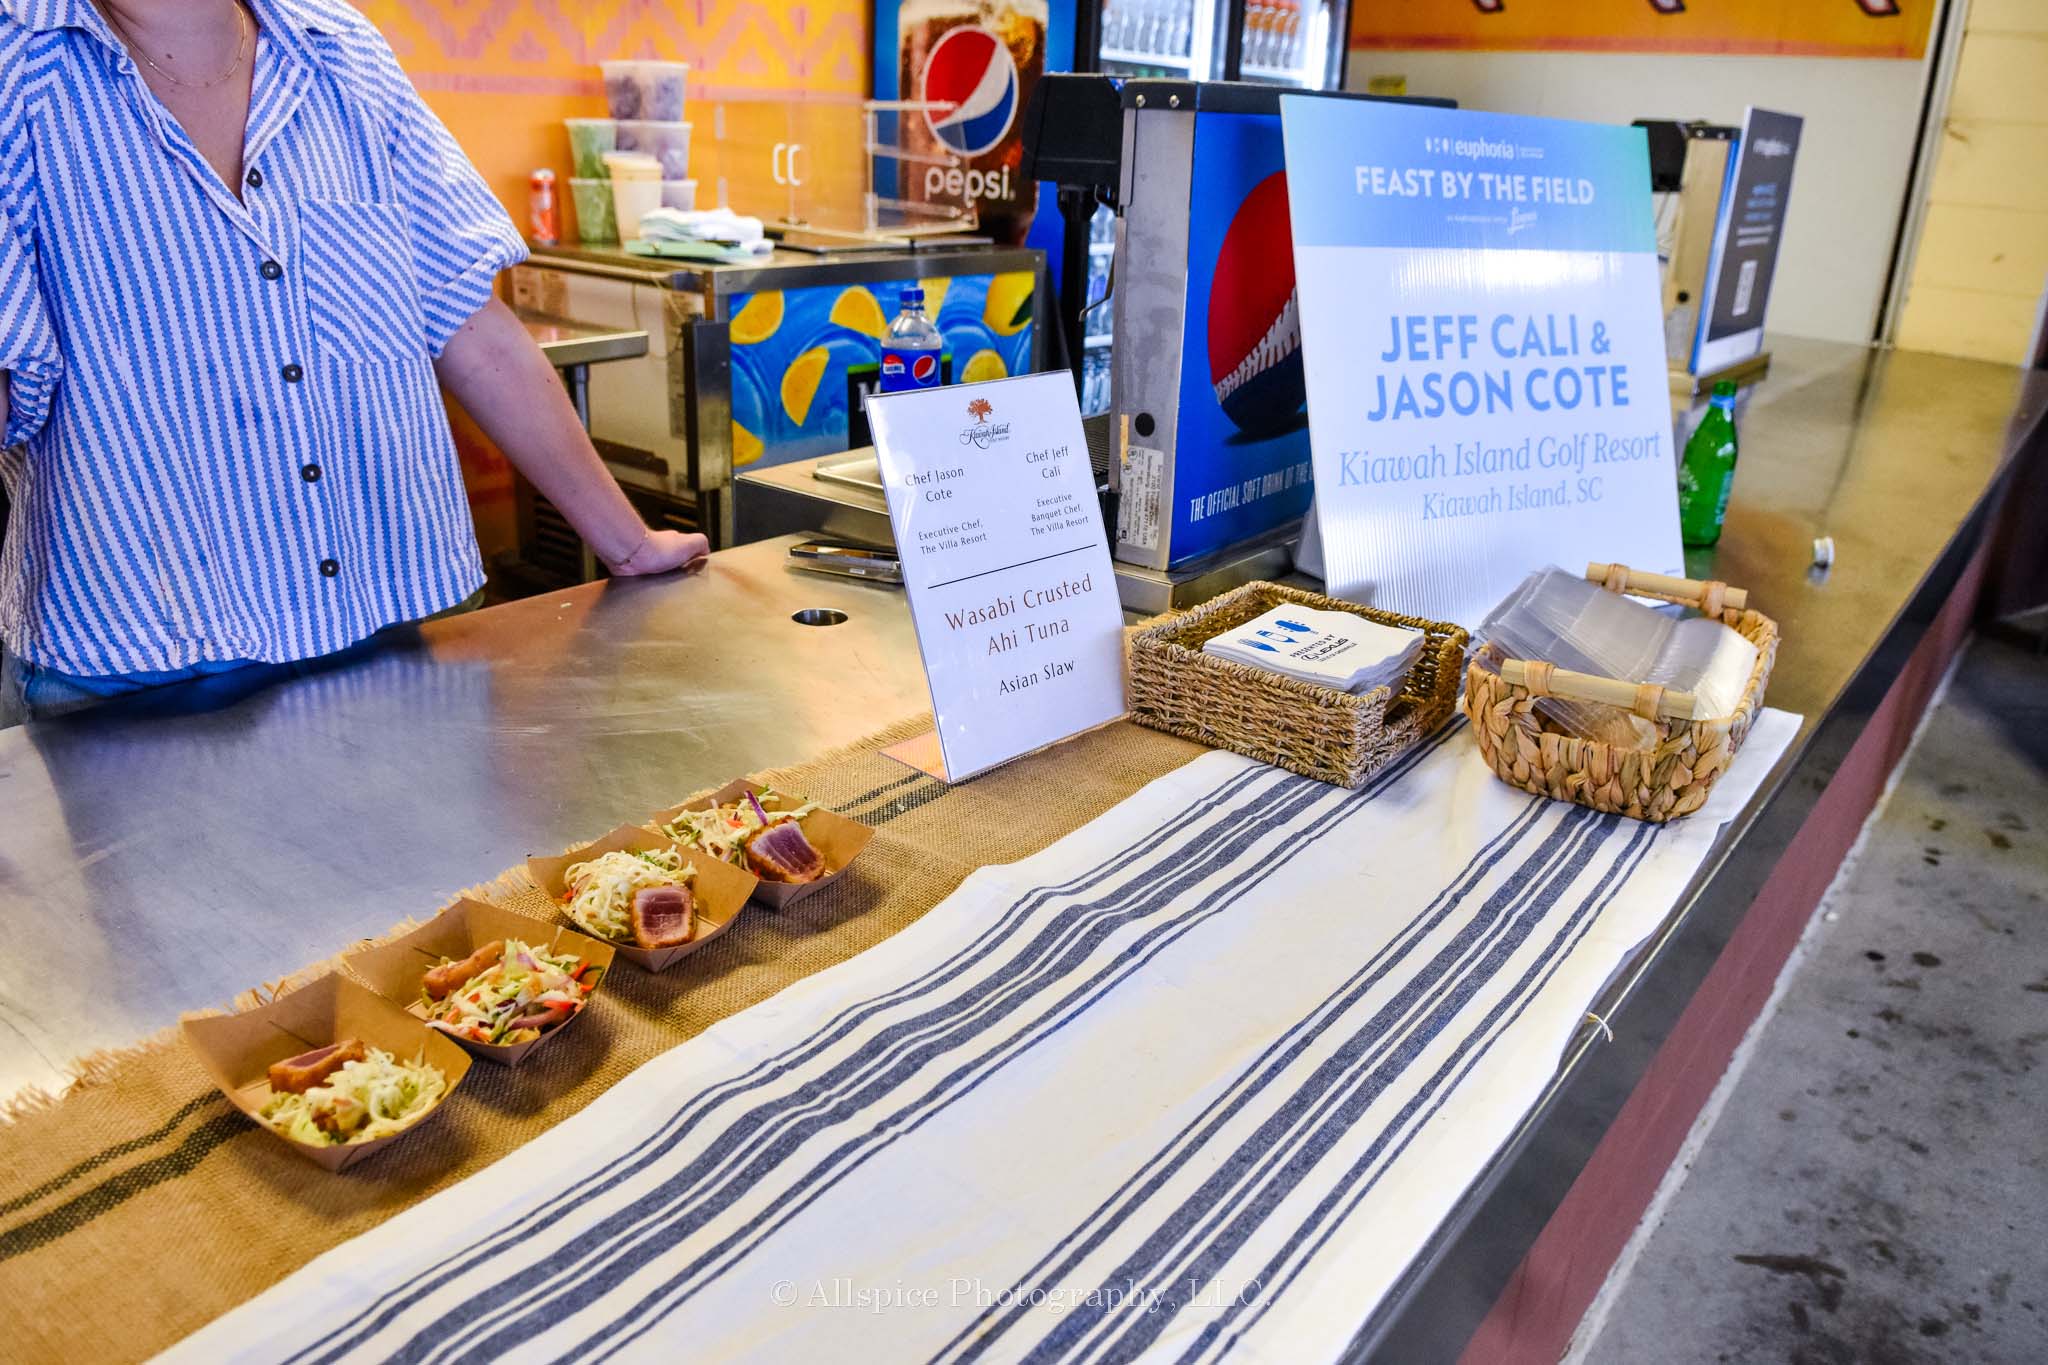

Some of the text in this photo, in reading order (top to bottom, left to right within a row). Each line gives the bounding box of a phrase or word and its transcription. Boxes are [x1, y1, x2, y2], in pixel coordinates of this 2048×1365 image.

[1455, 136, 1514, 160] euphoria
[925, 164, 1010, 206] pepsi
[1355, 166, 1595, 205] FEAST BY THE FIELD
[1381, 314, 1611, 362] JEFF CALI &
[1367, 365, 1630, 422] JASON COTE
[1026, 446, 1069, 464] Chef Jeff
[1338, 431, 1661, 487] Kiawah Island Golf Resort
[905, 467, 964, 487] Chef Jason
[1042, 465, 1061, 479] Cali
[926, 488, 952, 502] Cote
[1037, 494, 1072, 507] Executive
[1190, 496, 1205, 523] THE
[1207, 484, 1240, 517] OFFICIAL
[1242, 477, 1261, 504] SOFT
[1422, 476, 1604, 520] Kiawah Island, SC
[1031, 508, 1062, 522] Banquet
[1031, 515, 1089, 536] The Villa Resort
[918, 526, 959, 541] Executive
[920, 532, 987, 555] The Villa Resort
[945, 573, 1092, 631] Wasabi Crusted
[988, 619, 1069, 656] Ahi Tuna
[999, 660, 1075, 696] Asian Slaw
